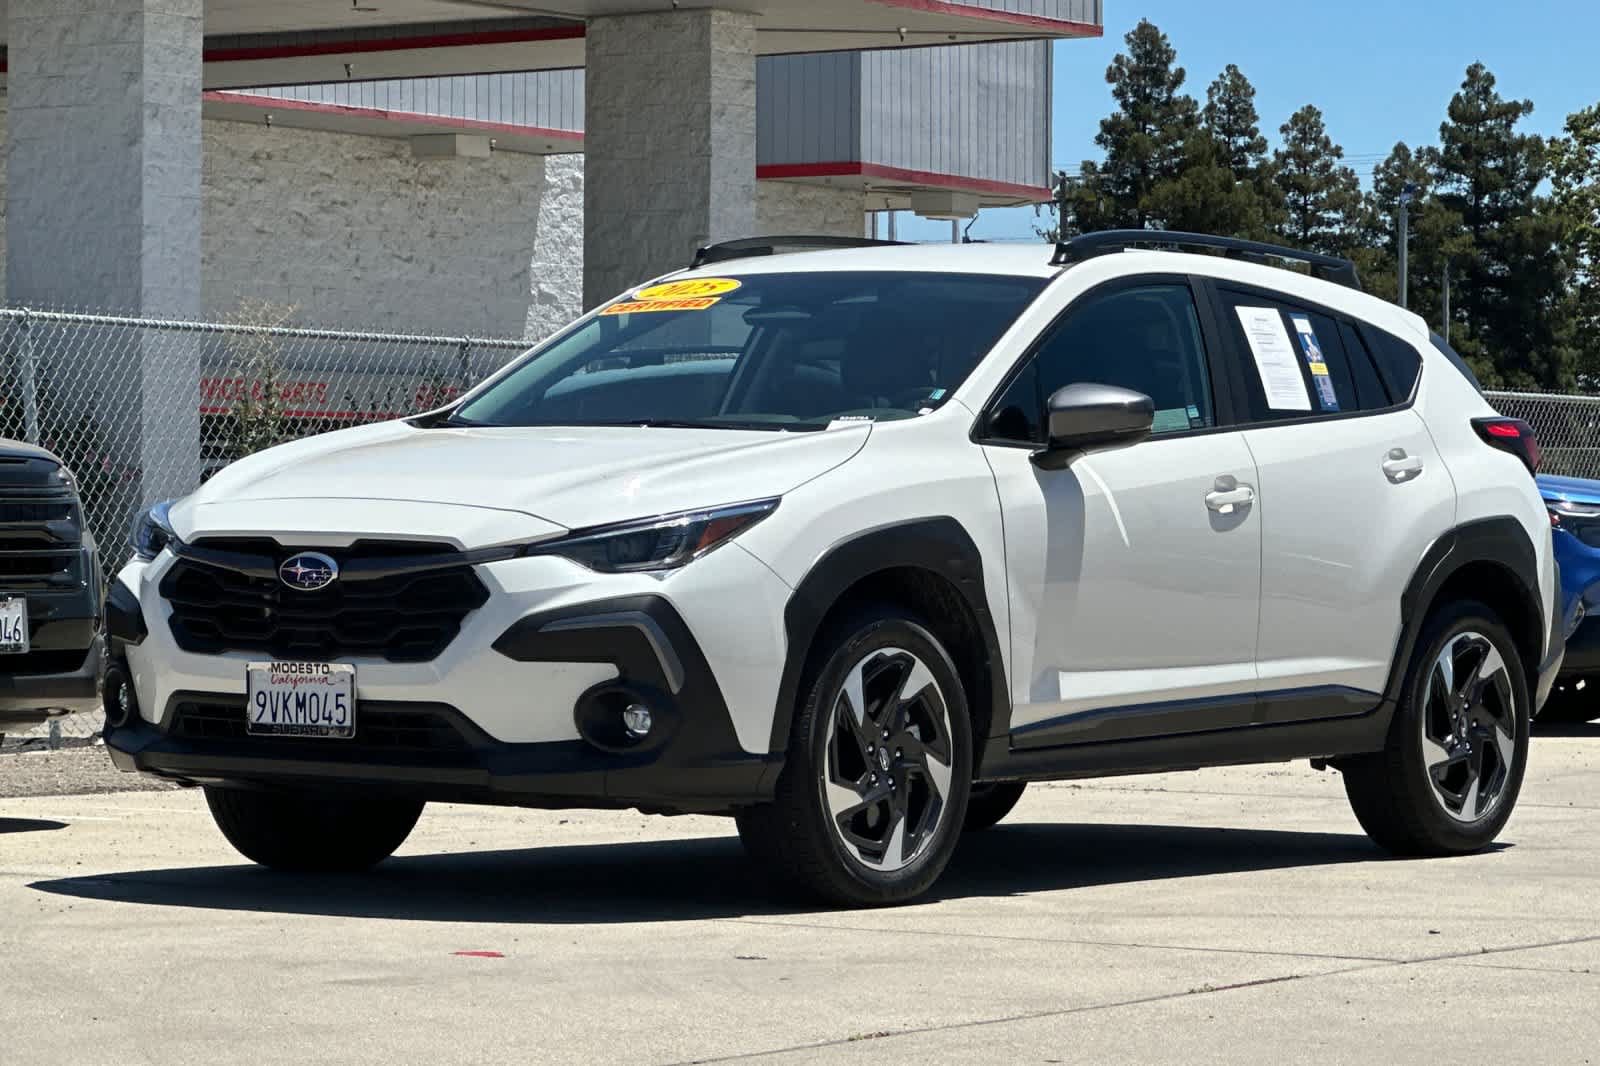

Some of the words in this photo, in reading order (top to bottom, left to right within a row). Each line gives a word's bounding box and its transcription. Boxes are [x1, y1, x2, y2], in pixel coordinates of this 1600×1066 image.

[604, 299, 715, 313] CERTIFIED
[271, 663, 330, 674] MODESTO
[271, 674, 329, 689] California
[256, 690, 346, 725] 9VKM045
